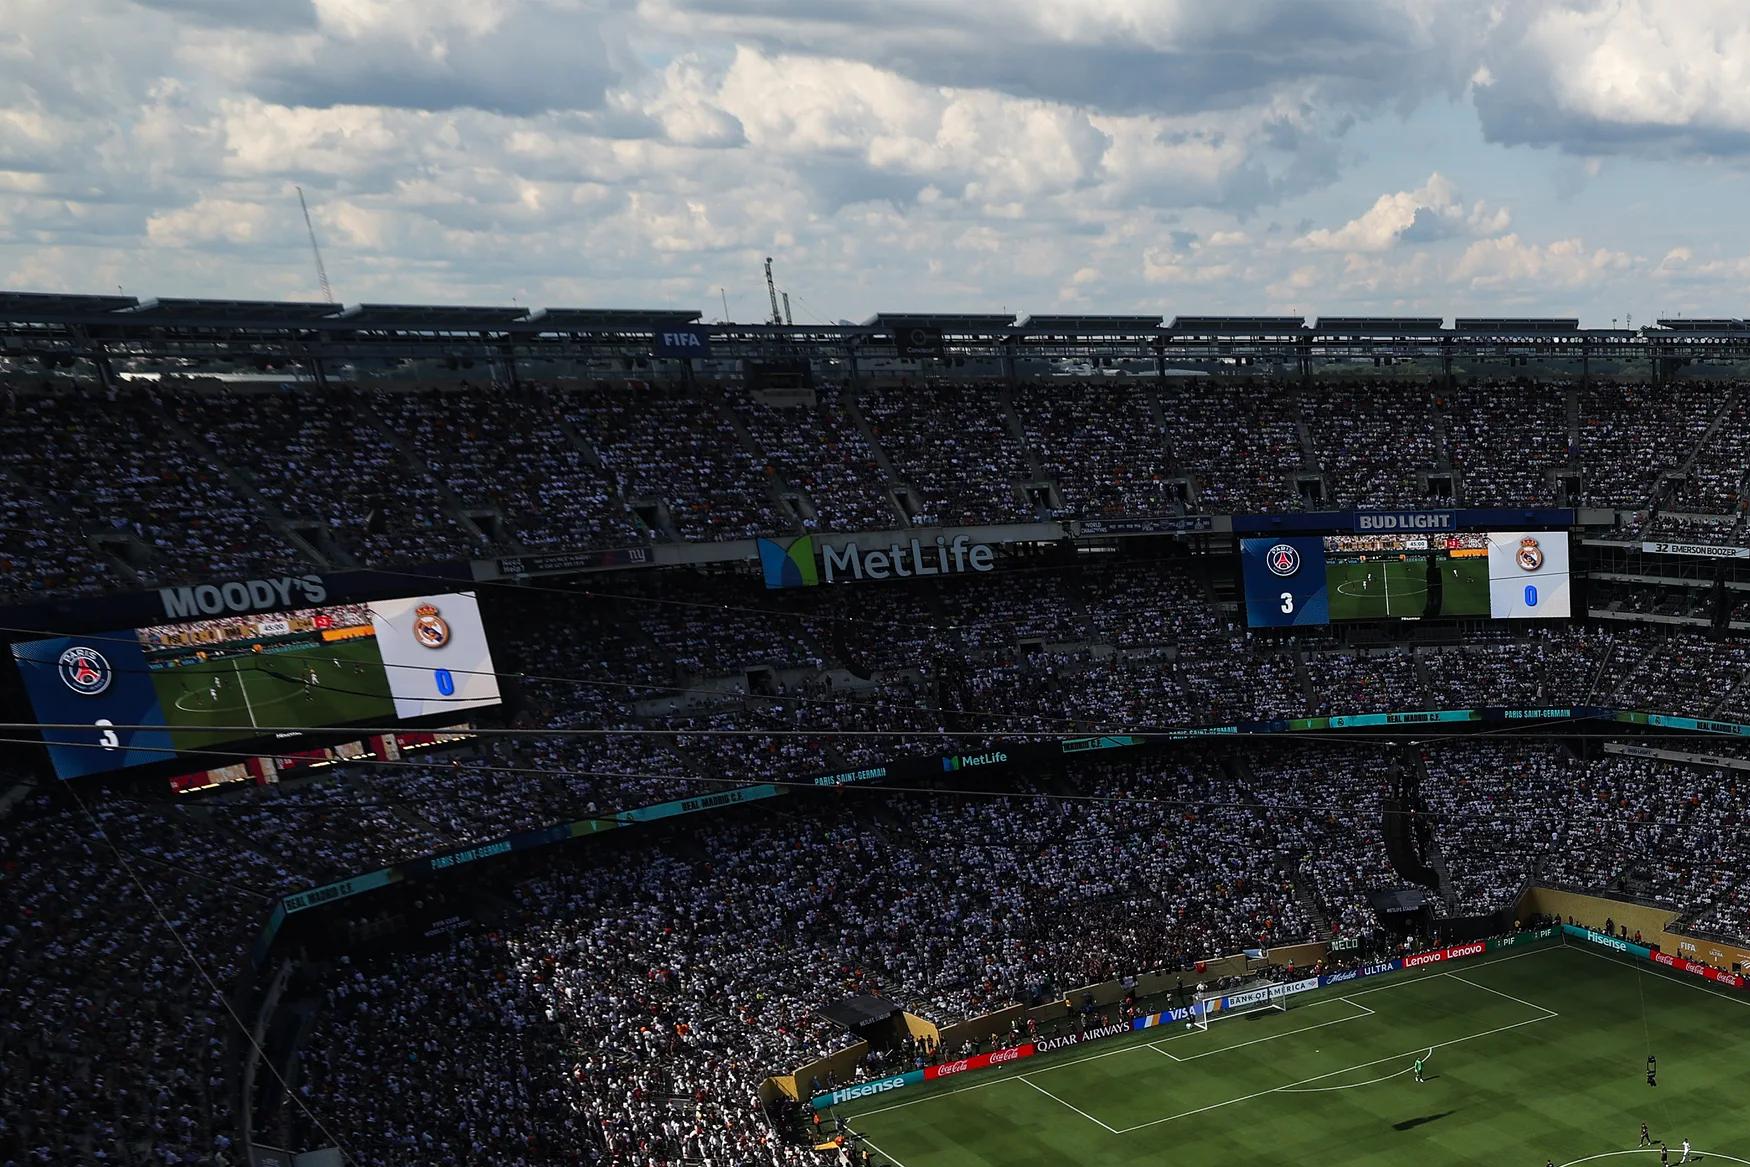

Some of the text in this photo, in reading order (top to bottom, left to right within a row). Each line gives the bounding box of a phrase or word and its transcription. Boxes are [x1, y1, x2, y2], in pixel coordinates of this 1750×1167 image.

[663, 333, 700, 346] FIFA
[1359, 514, 1450, 529] BUD LIGHT
[1655, 543, 1737, 557] 32 EMERSON BOOZER
[822, 535, 995, 583] MetLife
[160, 574, 327, 619] MOODY'S
[1280, 592, 1294, 614] 3
[1524, 585, 1538, 607] 0
[435, 669, 455, 696] 0
[1504, 709, 1571, 719] PARIS SAINT-GERMAIN
[94, 718, 119, 751] 3
[962, 751, 1008, 767] MetLife
[814, 776, 835, 787] PARIS
[1541, 928, 1552, 938] PIF
[1587, 930, 1628, 952] Hisense
[1503, 937, 1515, 946] PIF
[1680, 941, 1697, 953] FIFA
[1446, 943, 1482, 959] Lenovo
[1655, 952, 1673, 966] Coca-Cola
[1405, 952, 1441, 968] Lenovo
[1326, 962, 1394, 985] Michelob ULTRA
[1685, 961, 1704, 976] Coca-Cola
[1716, 971, 1736, 986] Coca-Cola
[1229, 982, 1306, 1007] BANK OF AMERICA
[1169, 1005, 1197, 1022] VISA
[1037, 1020, 1131, 1053] QATAR AIRWAYS
[989, 1047, 1019, 1065] Coca-Cola
[937, 1059, 968, 1077] Coca-Cola
[832, 1075, 905, 1105] Hisense
